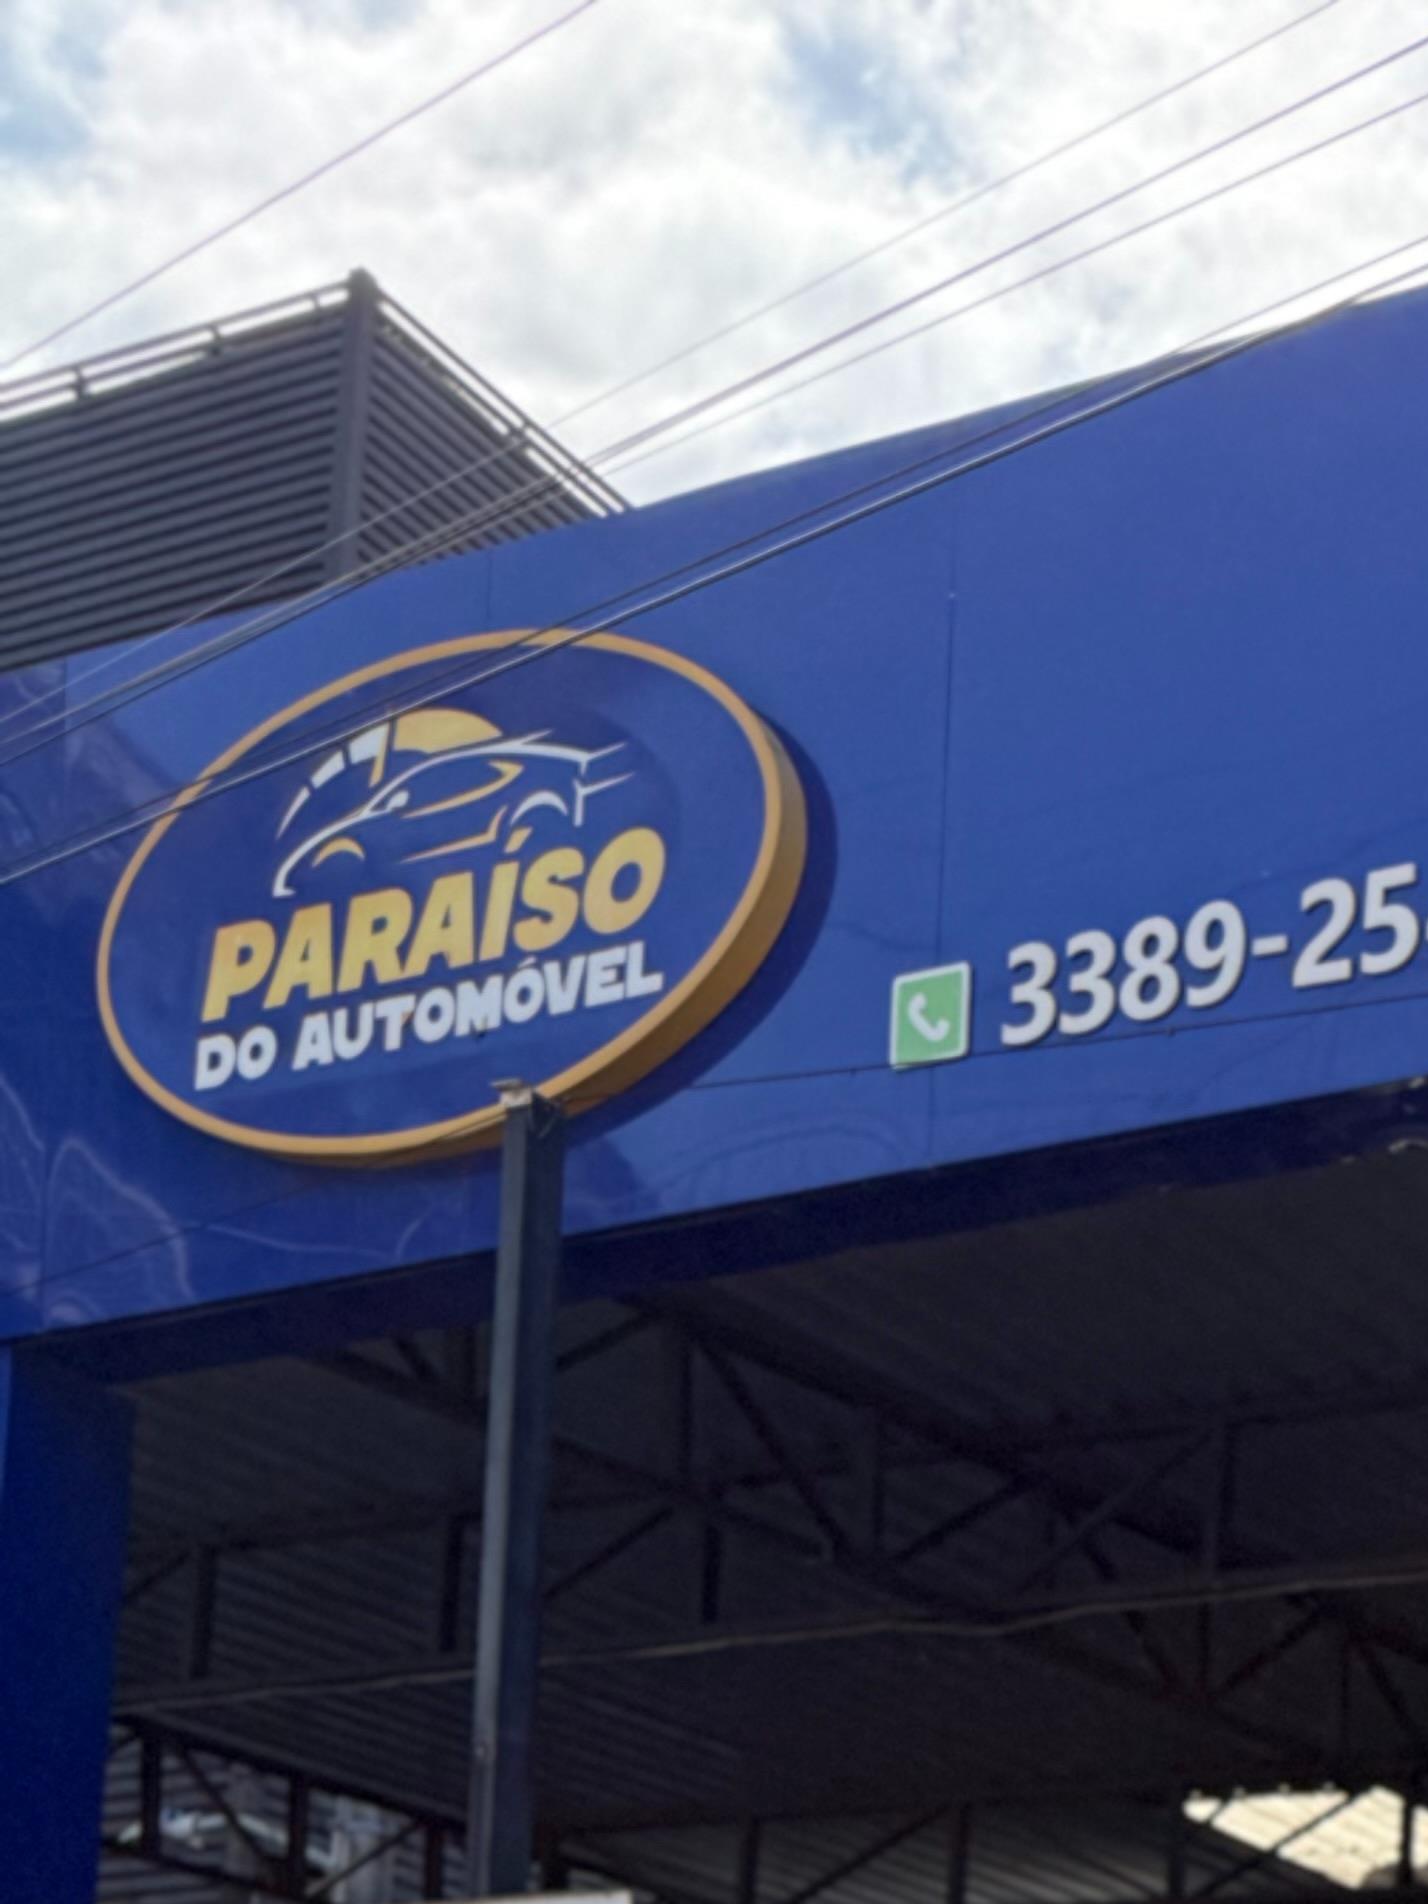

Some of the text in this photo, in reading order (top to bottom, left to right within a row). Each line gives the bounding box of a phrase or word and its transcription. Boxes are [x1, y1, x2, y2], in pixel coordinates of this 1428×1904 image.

[201, 825, 667, 1023] PARAÍSO
[194, 941, 664, 1090] DO AUTOMÓVEL
